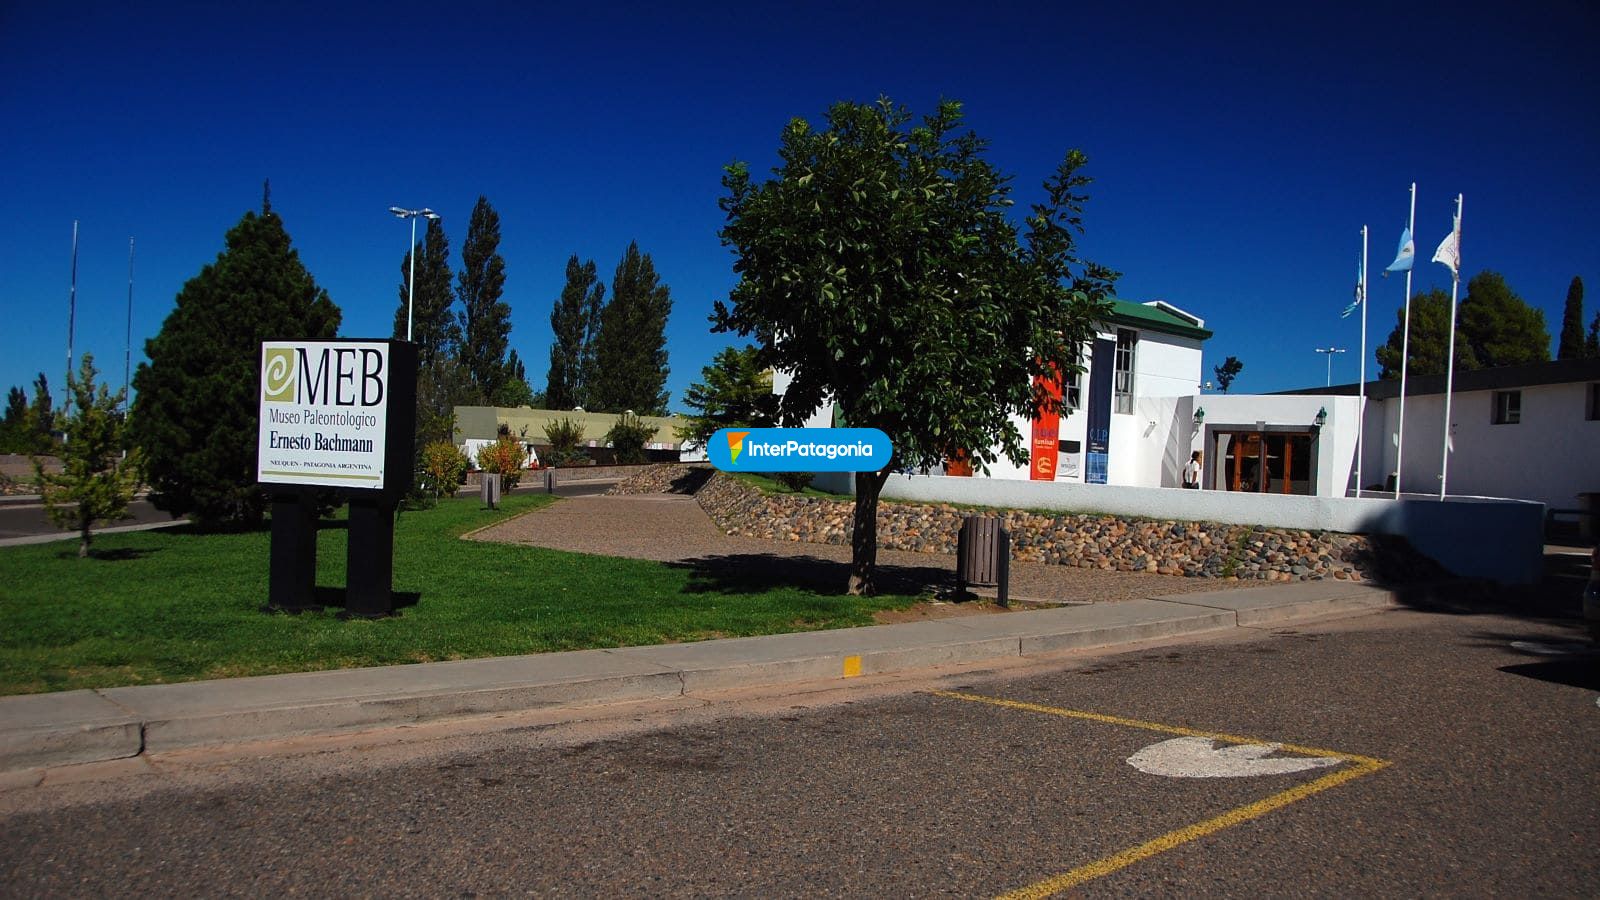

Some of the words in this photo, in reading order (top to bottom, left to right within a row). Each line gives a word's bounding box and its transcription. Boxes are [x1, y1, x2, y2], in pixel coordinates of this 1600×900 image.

[295, 347, 384, 406] MEB
[269, 408, 300, 424] Museo
[303, 409, 376, 430] Paleontologico
[269, 430, 311, 450] Ernesto
[314, 432, 373, 453] Bachmann
